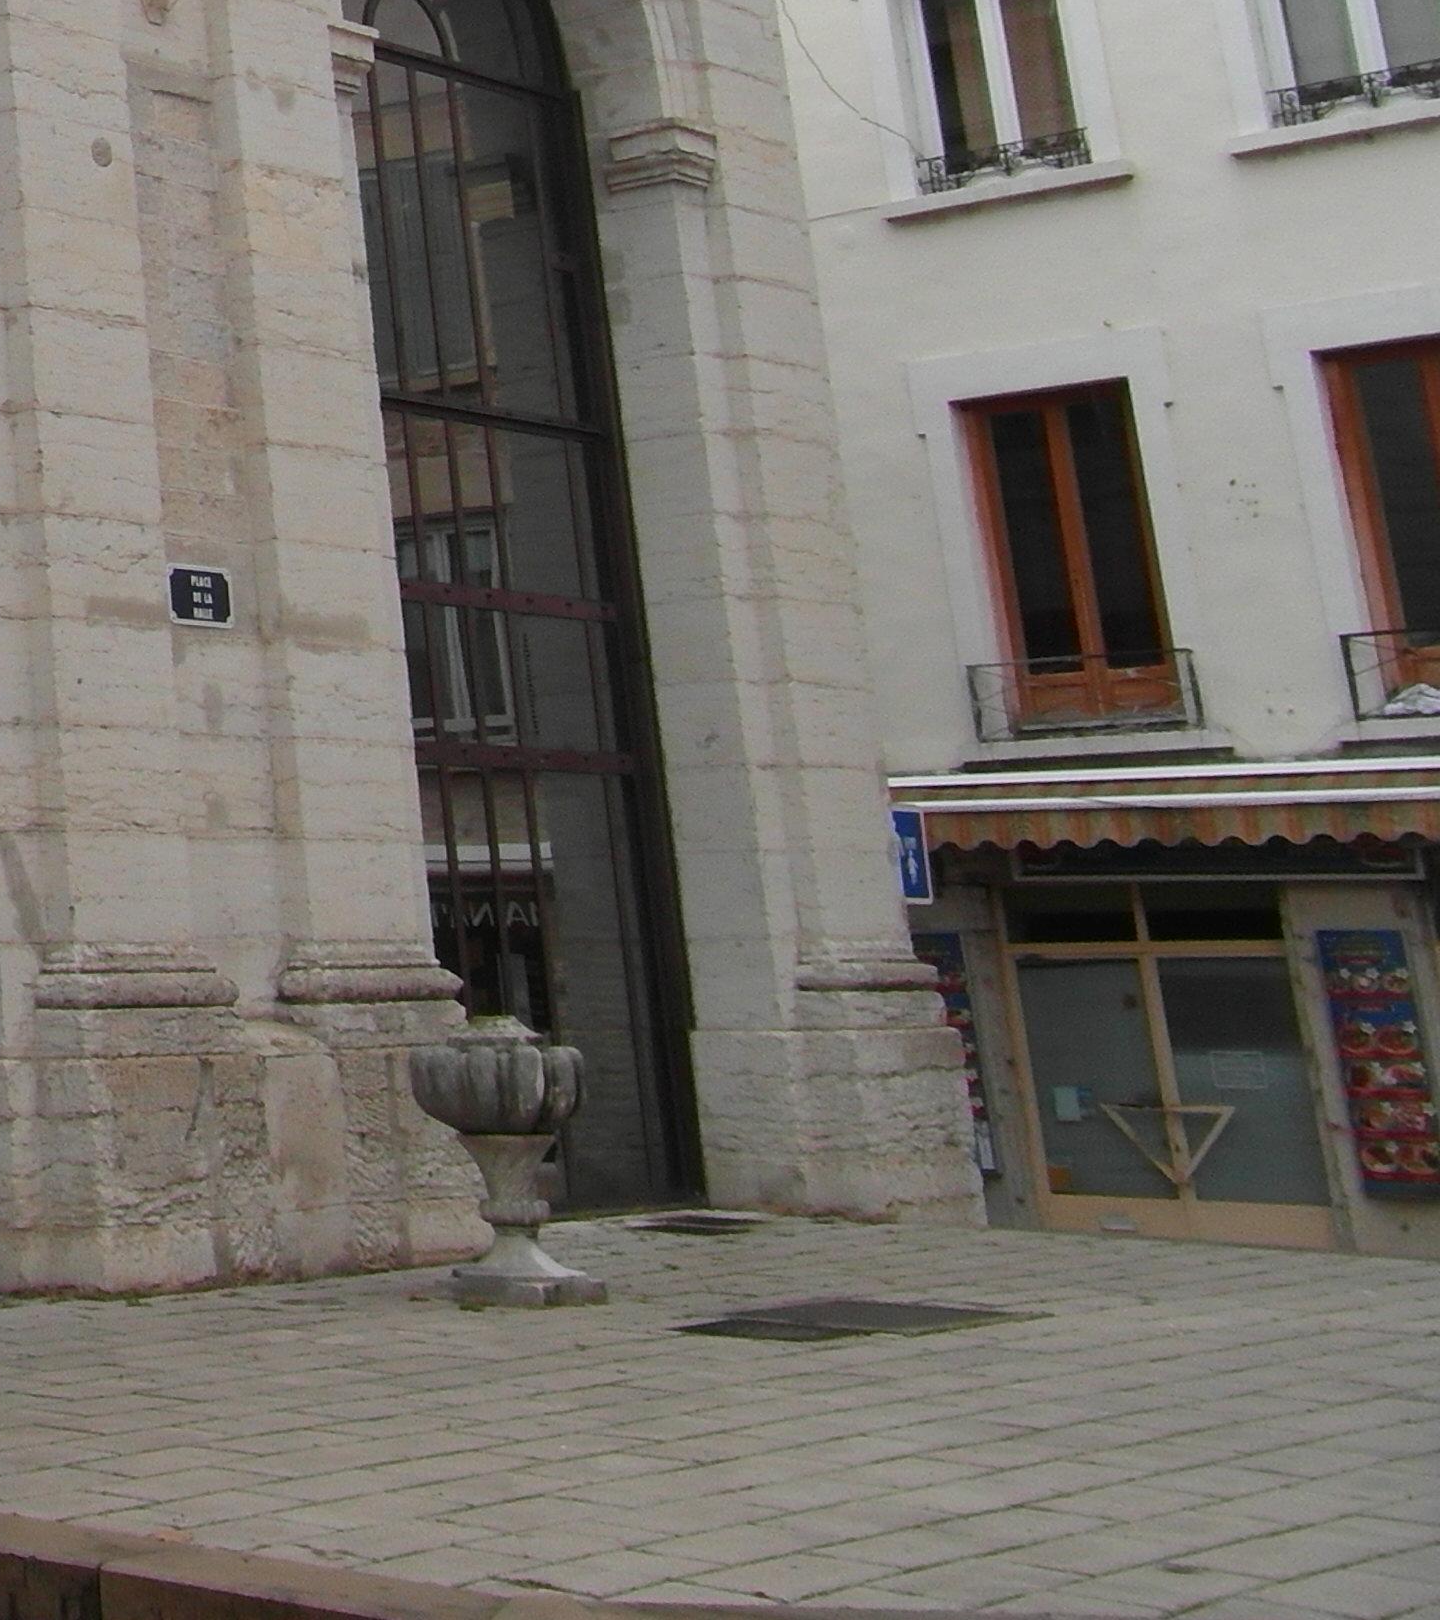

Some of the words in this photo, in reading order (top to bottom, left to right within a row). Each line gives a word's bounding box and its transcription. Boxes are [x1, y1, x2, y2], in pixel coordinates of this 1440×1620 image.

[191, 575, 212, 588] PLACE
[193, 592, 202, 603] DE
[204, 593, 213, 604] LA
